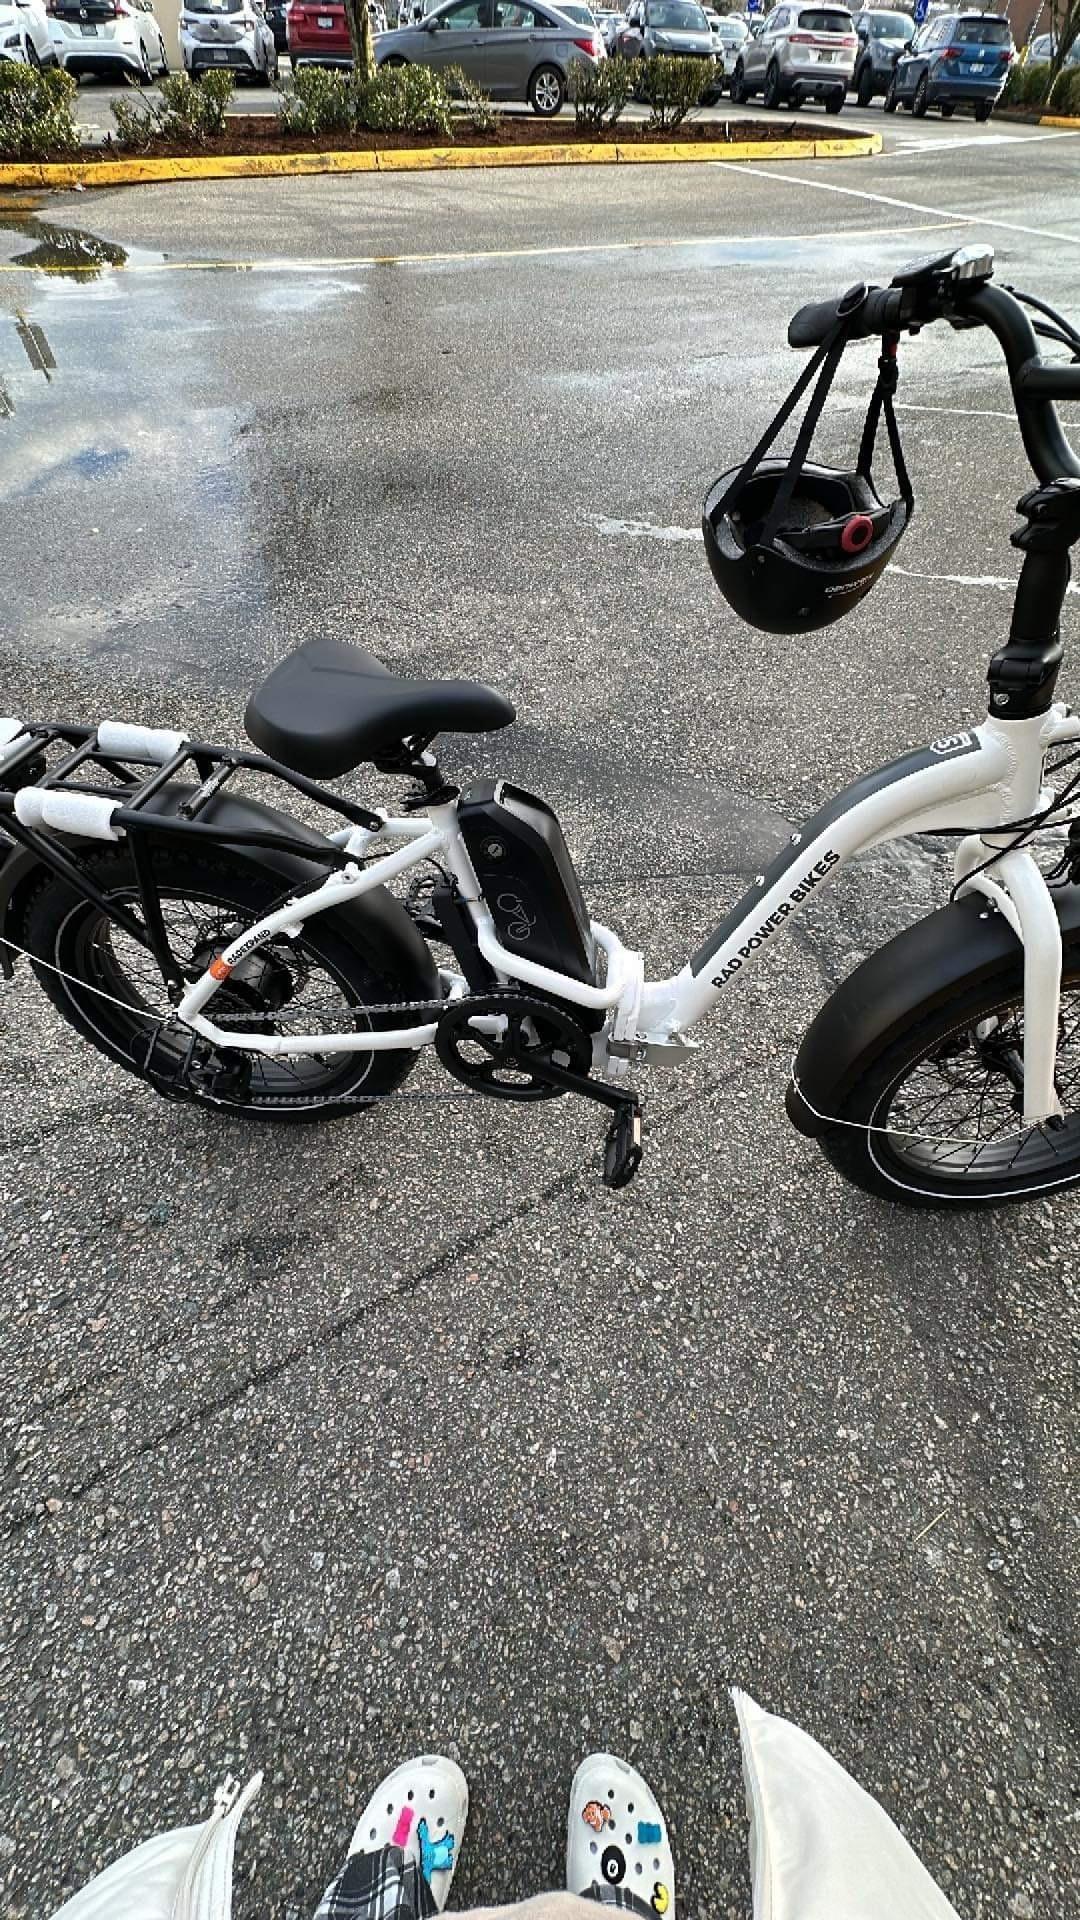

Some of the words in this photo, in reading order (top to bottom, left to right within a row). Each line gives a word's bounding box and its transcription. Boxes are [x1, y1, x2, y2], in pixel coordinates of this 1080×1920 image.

[711, 958, 742, 988] RAD
[738, 902, 794, 958] POWER
[790, 850, 840, 902] BIKES
